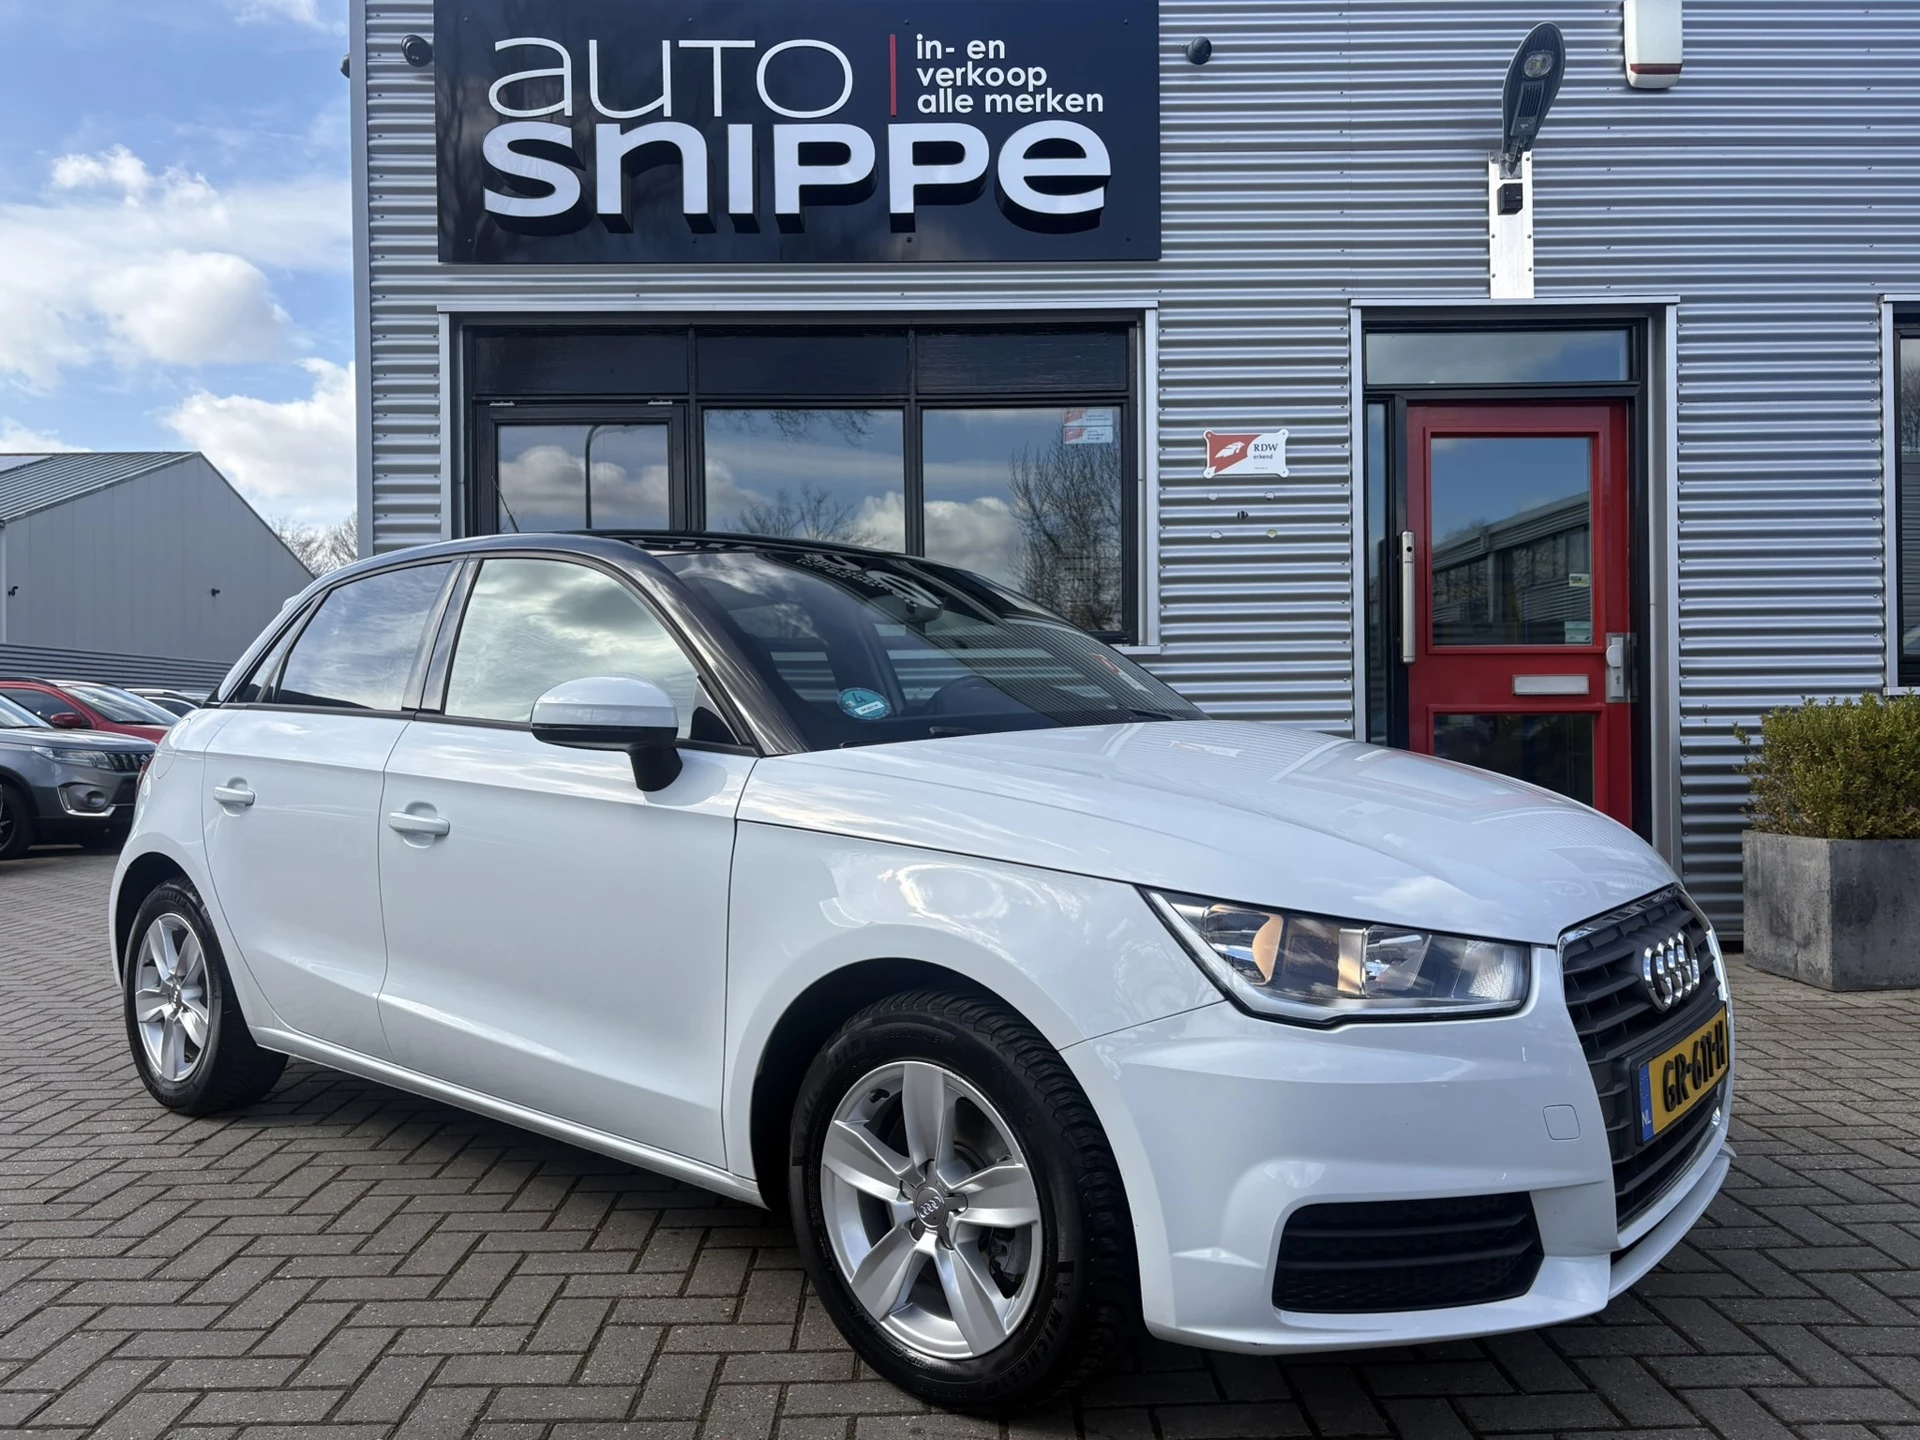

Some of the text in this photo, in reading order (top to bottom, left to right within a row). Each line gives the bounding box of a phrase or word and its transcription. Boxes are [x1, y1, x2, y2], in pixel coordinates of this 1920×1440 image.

[916, 34, 1006, 60] in- en
[916, 61, 1048, 93] verkoop
[917, 87, 1104, 114] alle merken
[1253, 443, 1278, 452] RDW
[1662, 1020, 1725, 1112] GR-611-H
[1641, 1108, 1652, 1127] NL
